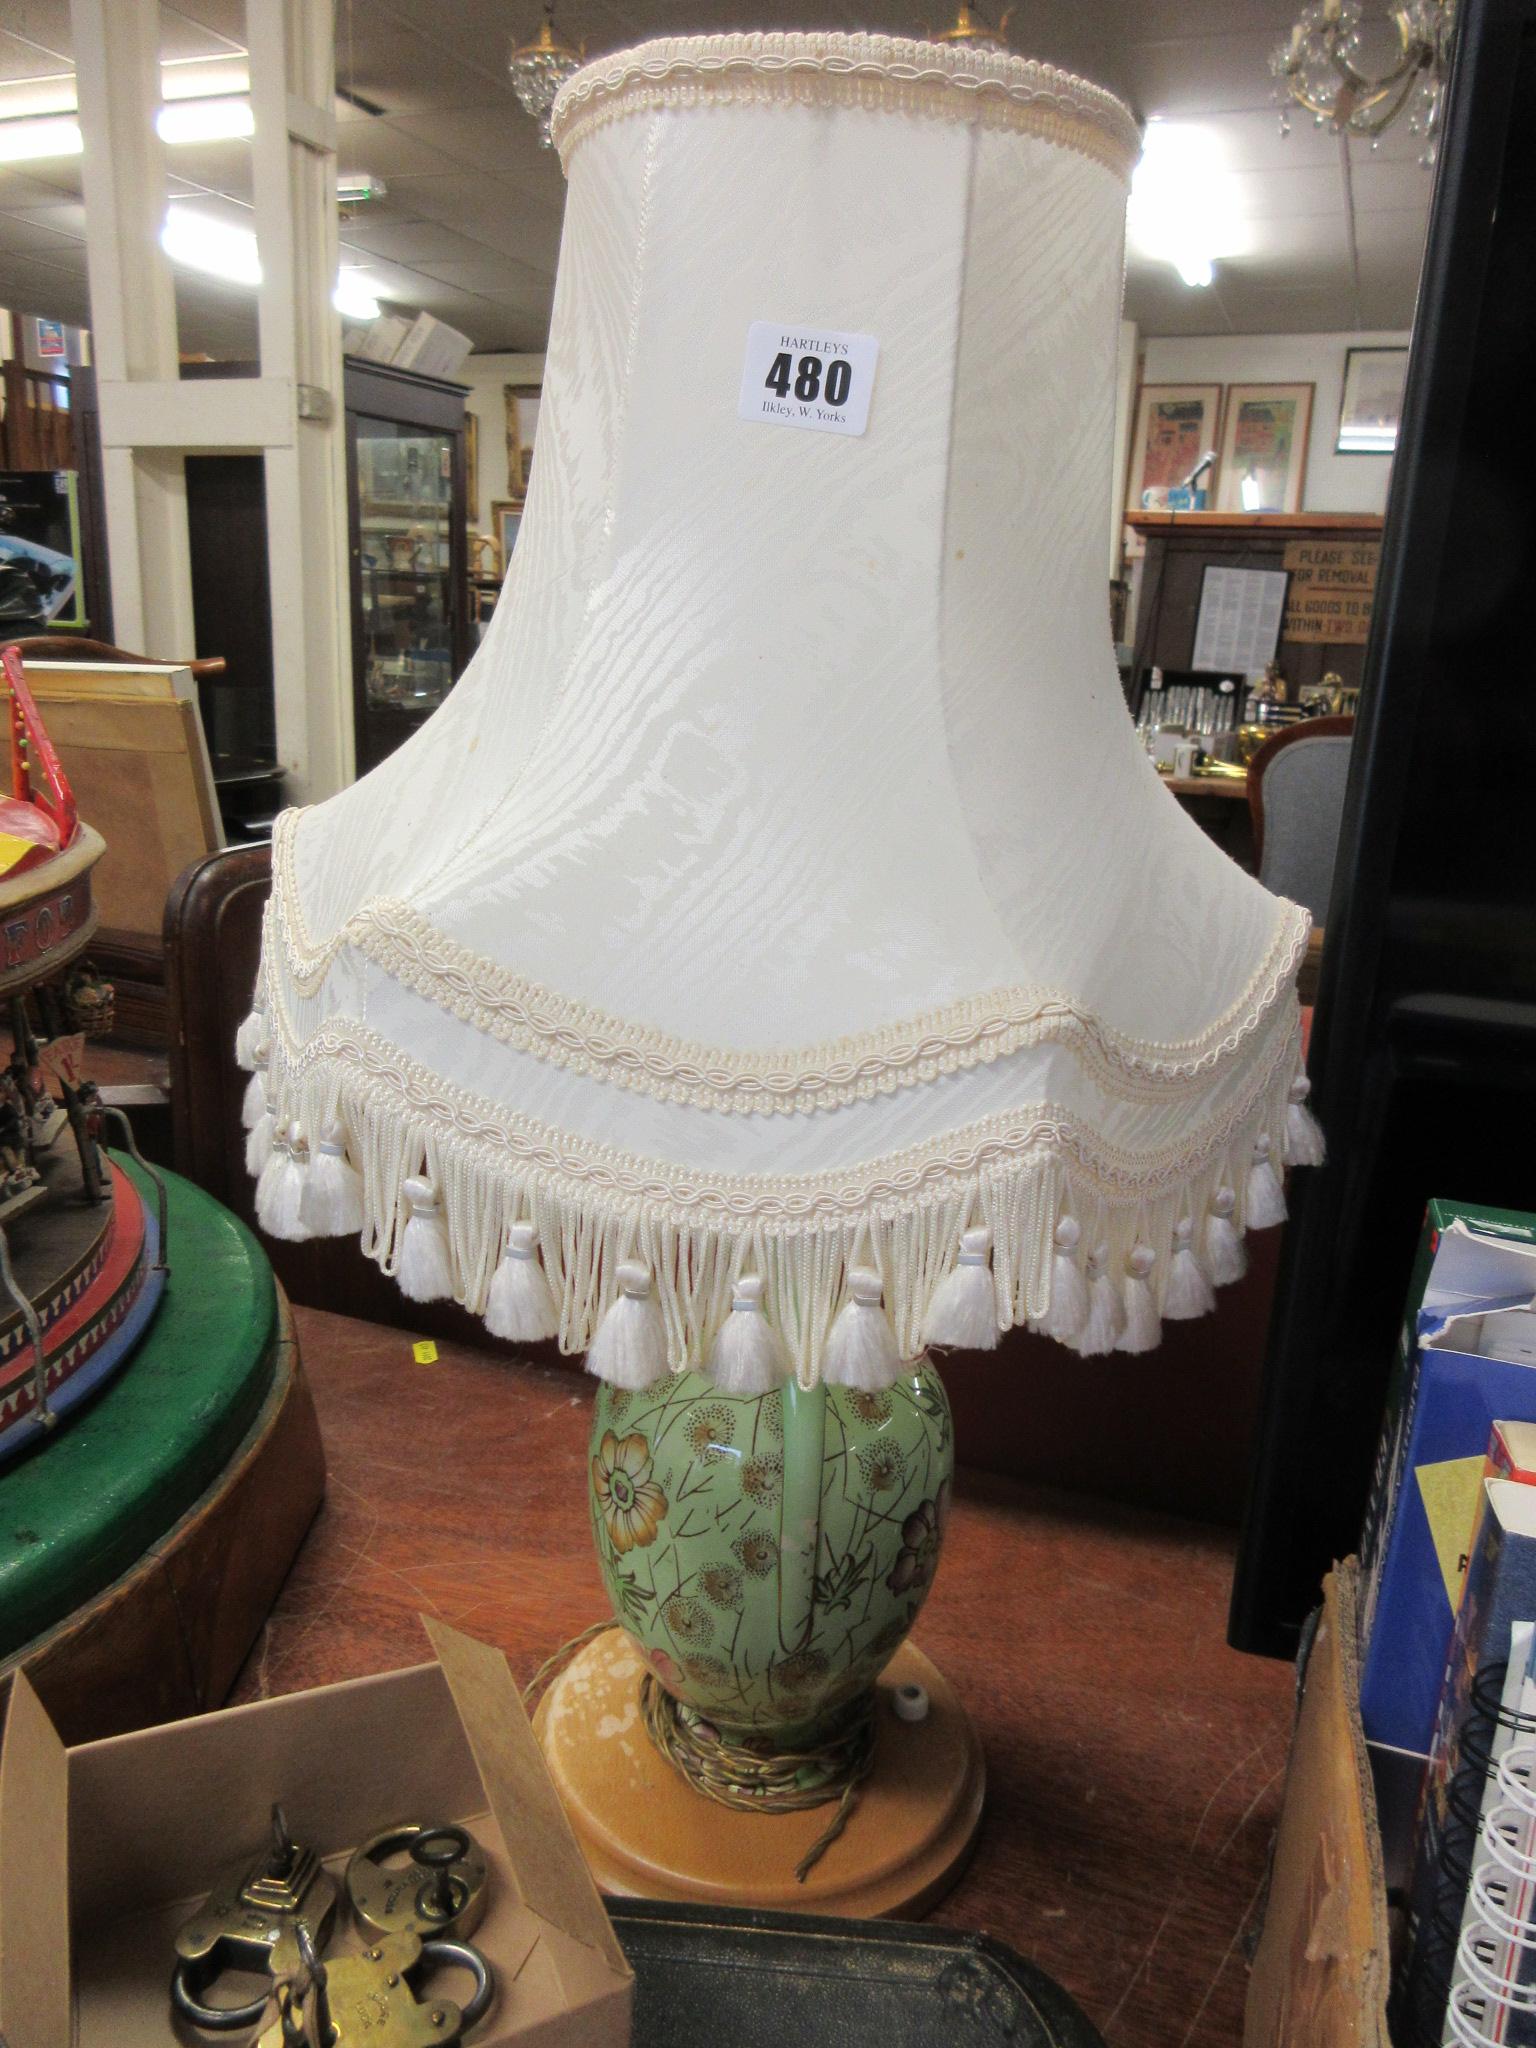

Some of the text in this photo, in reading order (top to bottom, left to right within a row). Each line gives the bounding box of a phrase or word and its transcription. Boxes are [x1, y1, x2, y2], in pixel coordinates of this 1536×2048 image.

[780, 336, 849, 355] HARTLEYS
[765, 352, 852, 407] 480
[762, 401, 847, 423] Ilkley, W. Yorks
[1300, 549, 1345, 564] PLEASE
[1318, 569, 1368, 583] REMOVAL
[1305, 600, 1342, 614] GOODS
